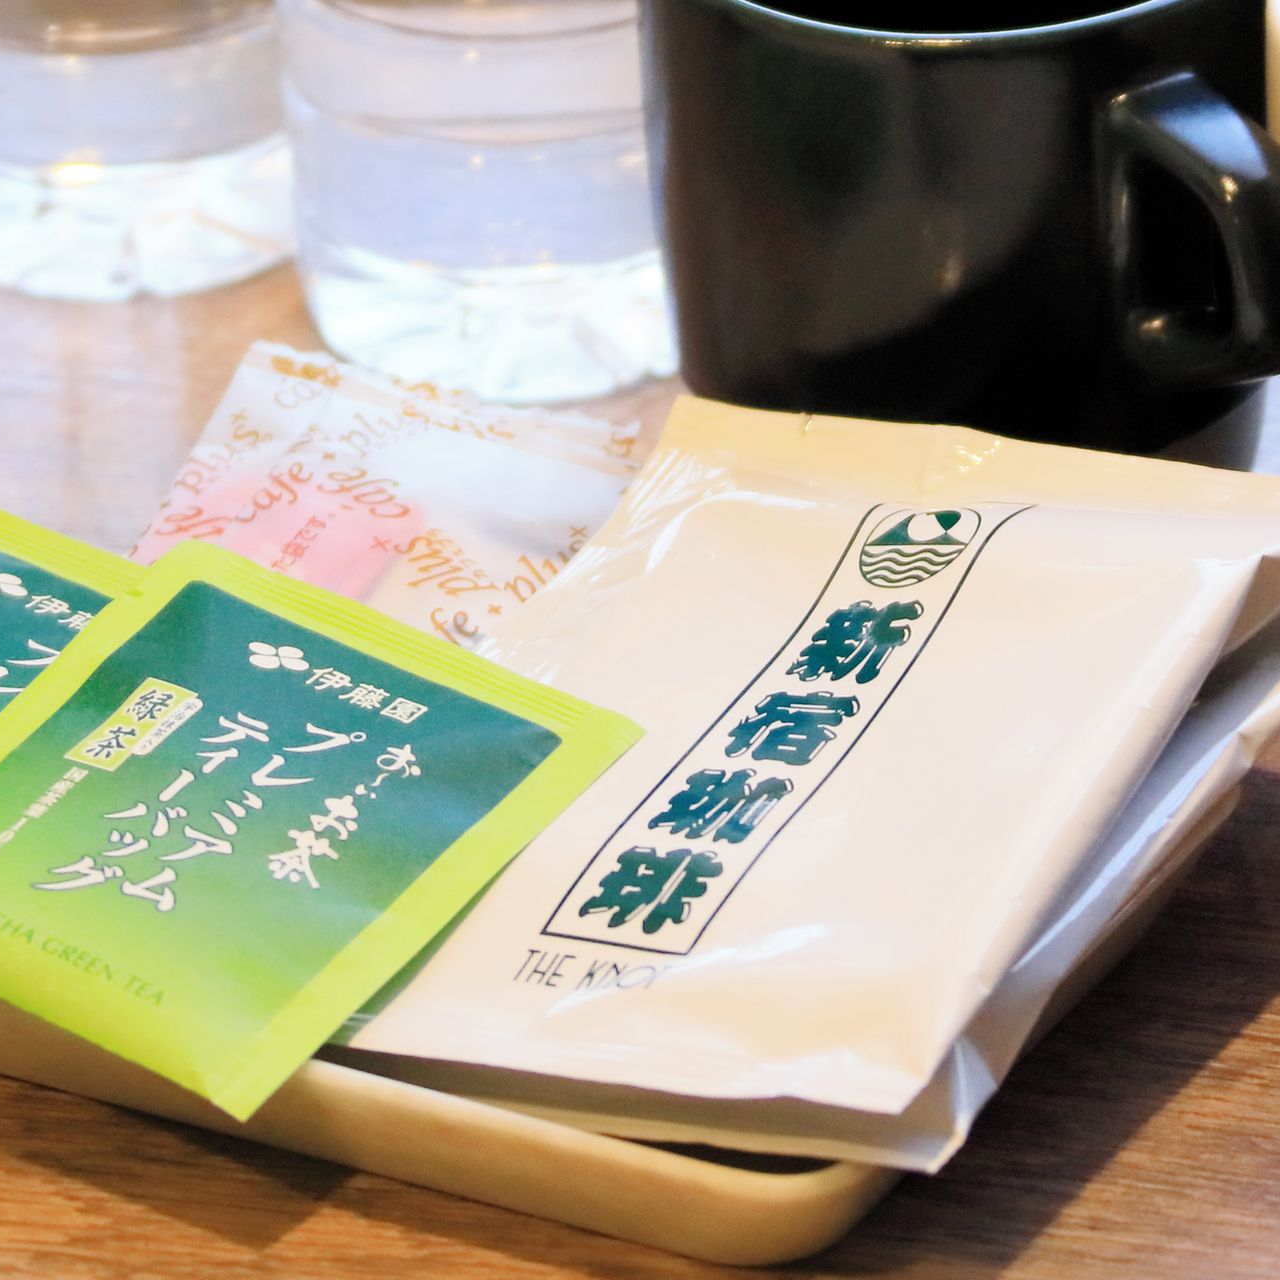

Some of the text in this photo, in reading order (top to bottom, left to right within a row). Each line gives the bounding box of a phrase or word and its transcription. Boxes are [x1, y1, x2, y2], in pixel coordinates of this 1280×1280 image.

[85, 688, 175, 760] 緑茶
[305, 666, 429, 724] 伊藤園
[31, 711, 270, 892] ティーバッグ
[577, 599, 925, 934] 新宿珈琲
[121, 722, 367, 913] プレミアム
[40, 934, 118, 982] GREEN
[124, 973, 166, 1006] TEA
[513, 949, 576, 988] THE
